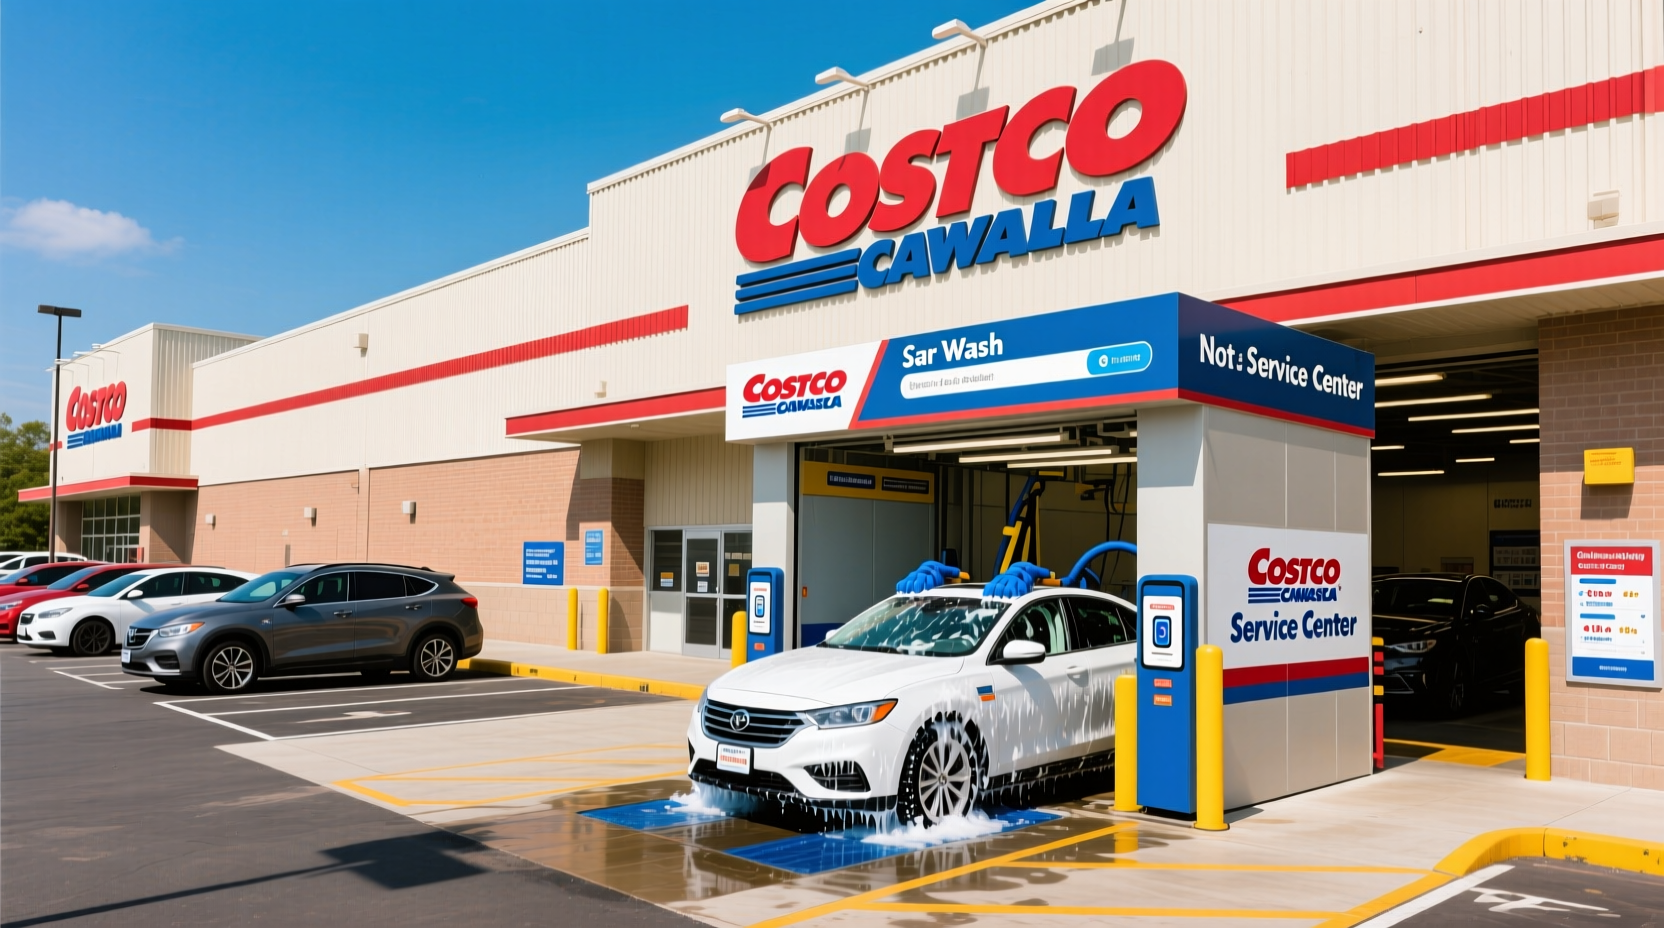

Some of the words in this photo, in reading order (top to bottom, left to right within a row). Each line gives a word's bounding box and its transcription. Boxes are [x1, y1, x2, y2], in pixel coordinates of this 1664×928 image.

[735, 59, 1188, 264] COSTCO
[857, 176, 1160, 289] CAWALLA
[902, 344, 938, 369] Sar
[941, 331, 1004, 362] Wash
[743, 370, 848, 403] COSTCO
[1246, 346, 1308, 388] Service
[1312, 364, 1364, 401] Center
[66, 380, 127, 432] COSTCO
[1248, 547, 1341, 586] COSTCO
[1230, 611, 1298, 643] Service
[1302, 610, 1357, 639] Center
